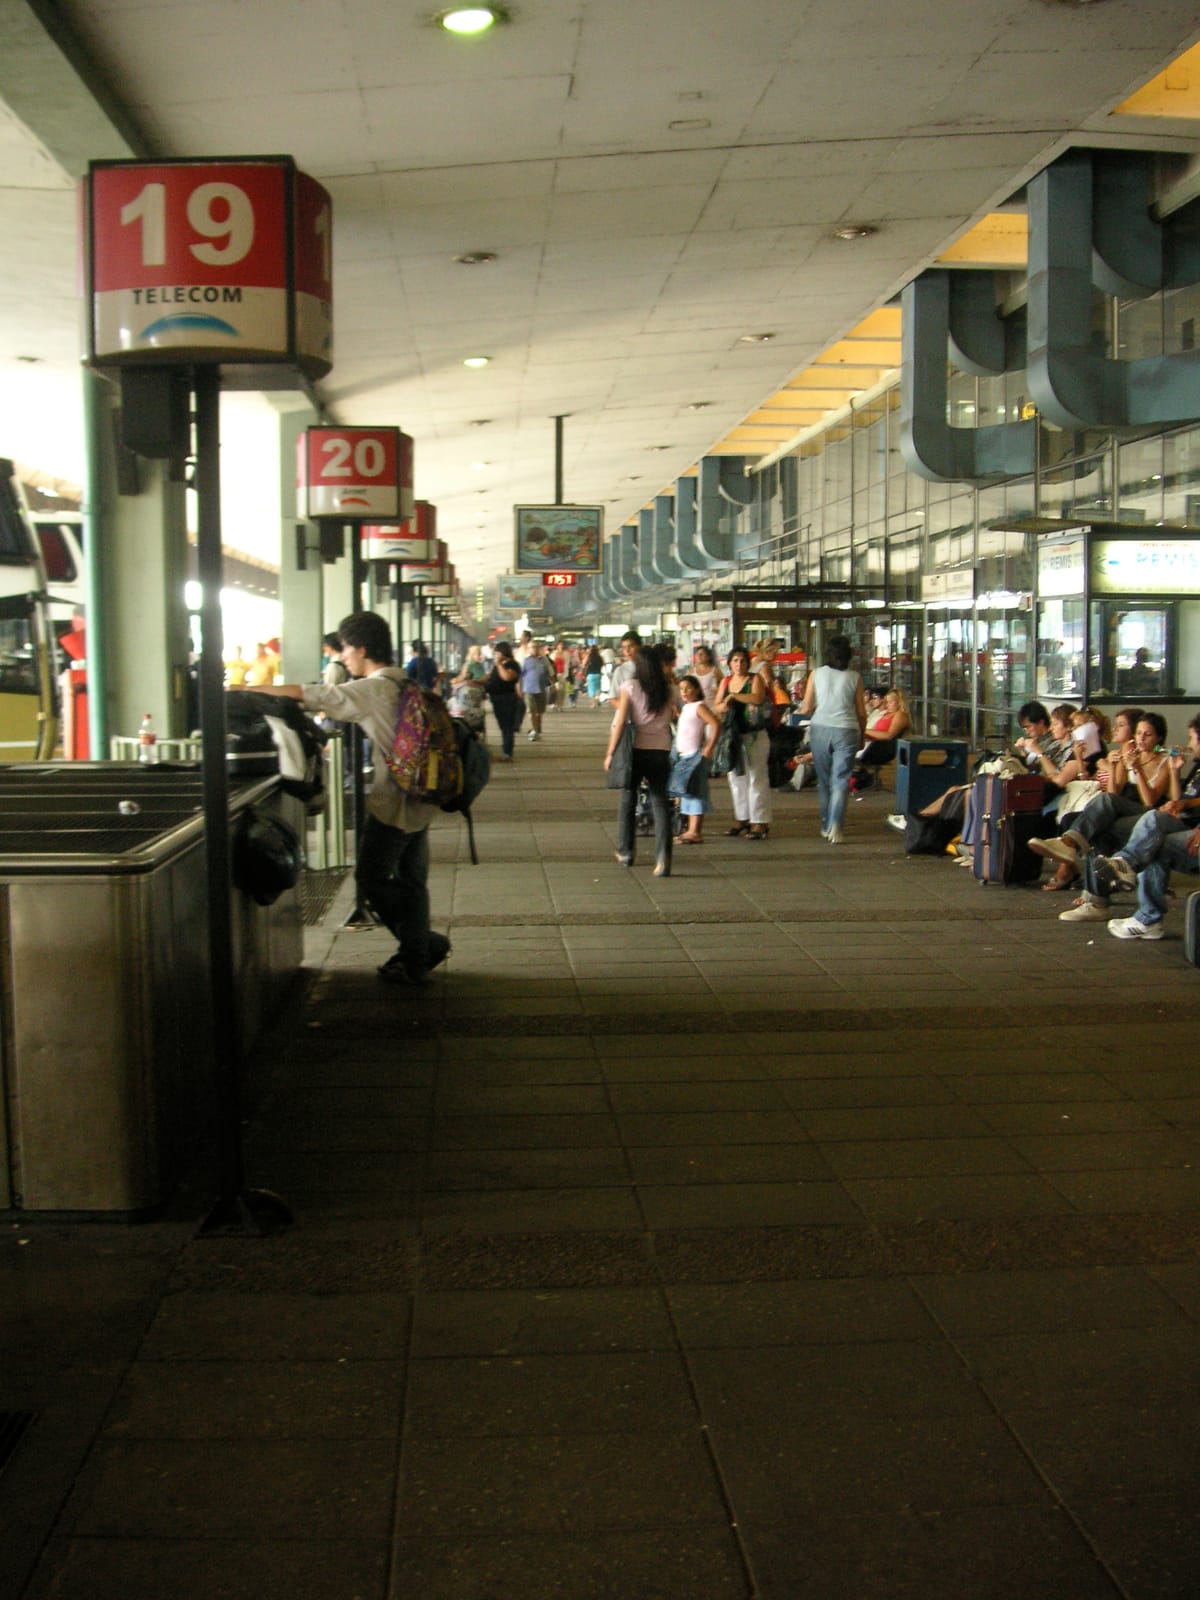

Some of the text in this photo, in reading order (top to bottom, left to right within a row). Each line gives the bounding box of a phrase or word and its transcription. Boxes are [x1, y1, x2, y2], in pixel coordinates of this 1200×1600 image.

[120, 182, 254, 267] 19
[132, 287, 243, 305] TELECOM
[319, 438, 386, 478] 20
